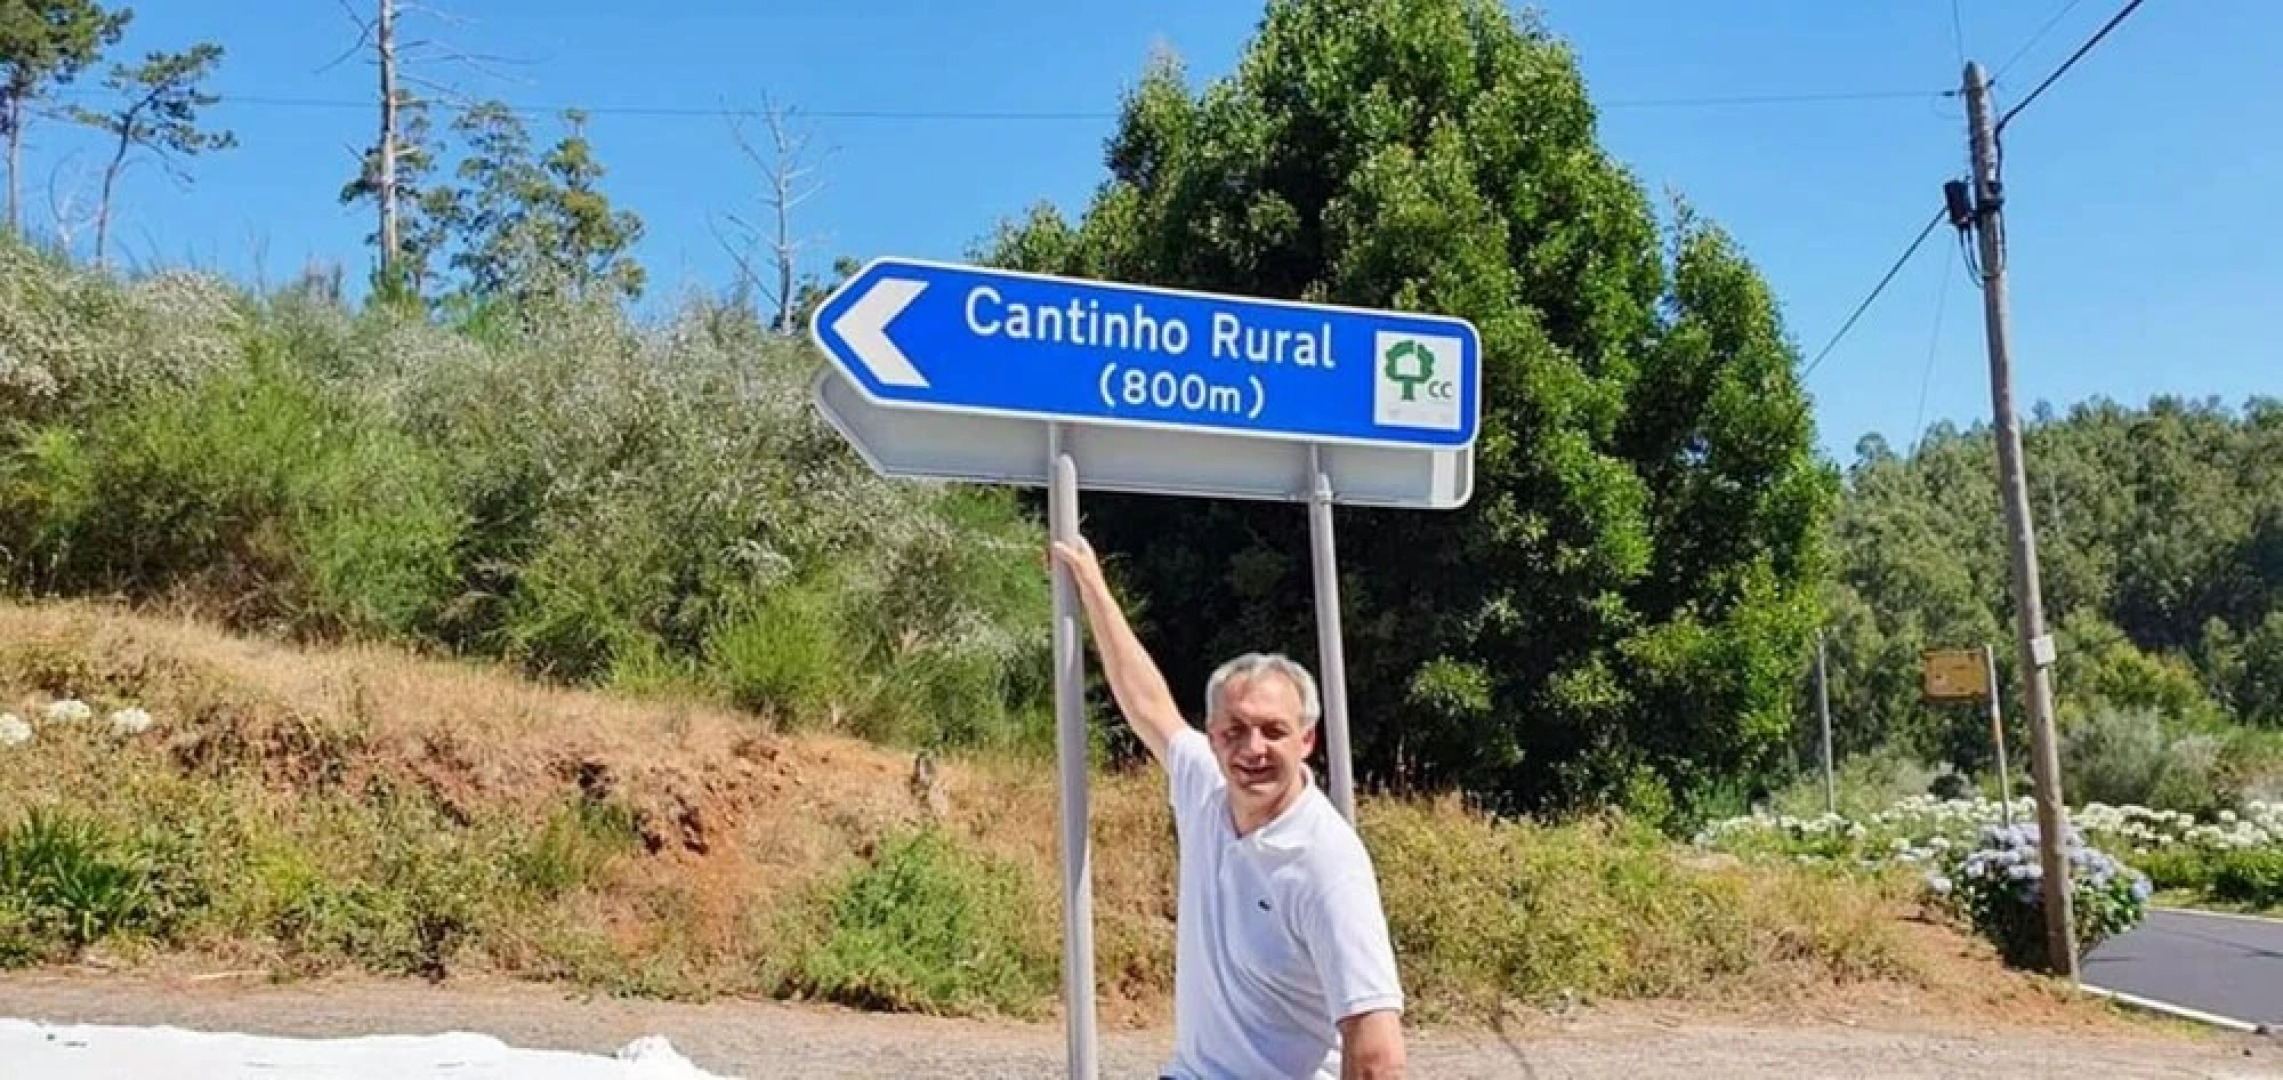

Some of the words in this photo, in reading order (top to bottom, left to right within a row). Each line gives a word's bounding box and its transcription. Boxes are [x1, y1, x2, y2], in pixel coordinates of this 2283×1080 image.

[965, 287, 1188, 354] Cantinho
[1212, 312, 1335, 367] Rural
[1100, 362, 1264, 419] (800m)
